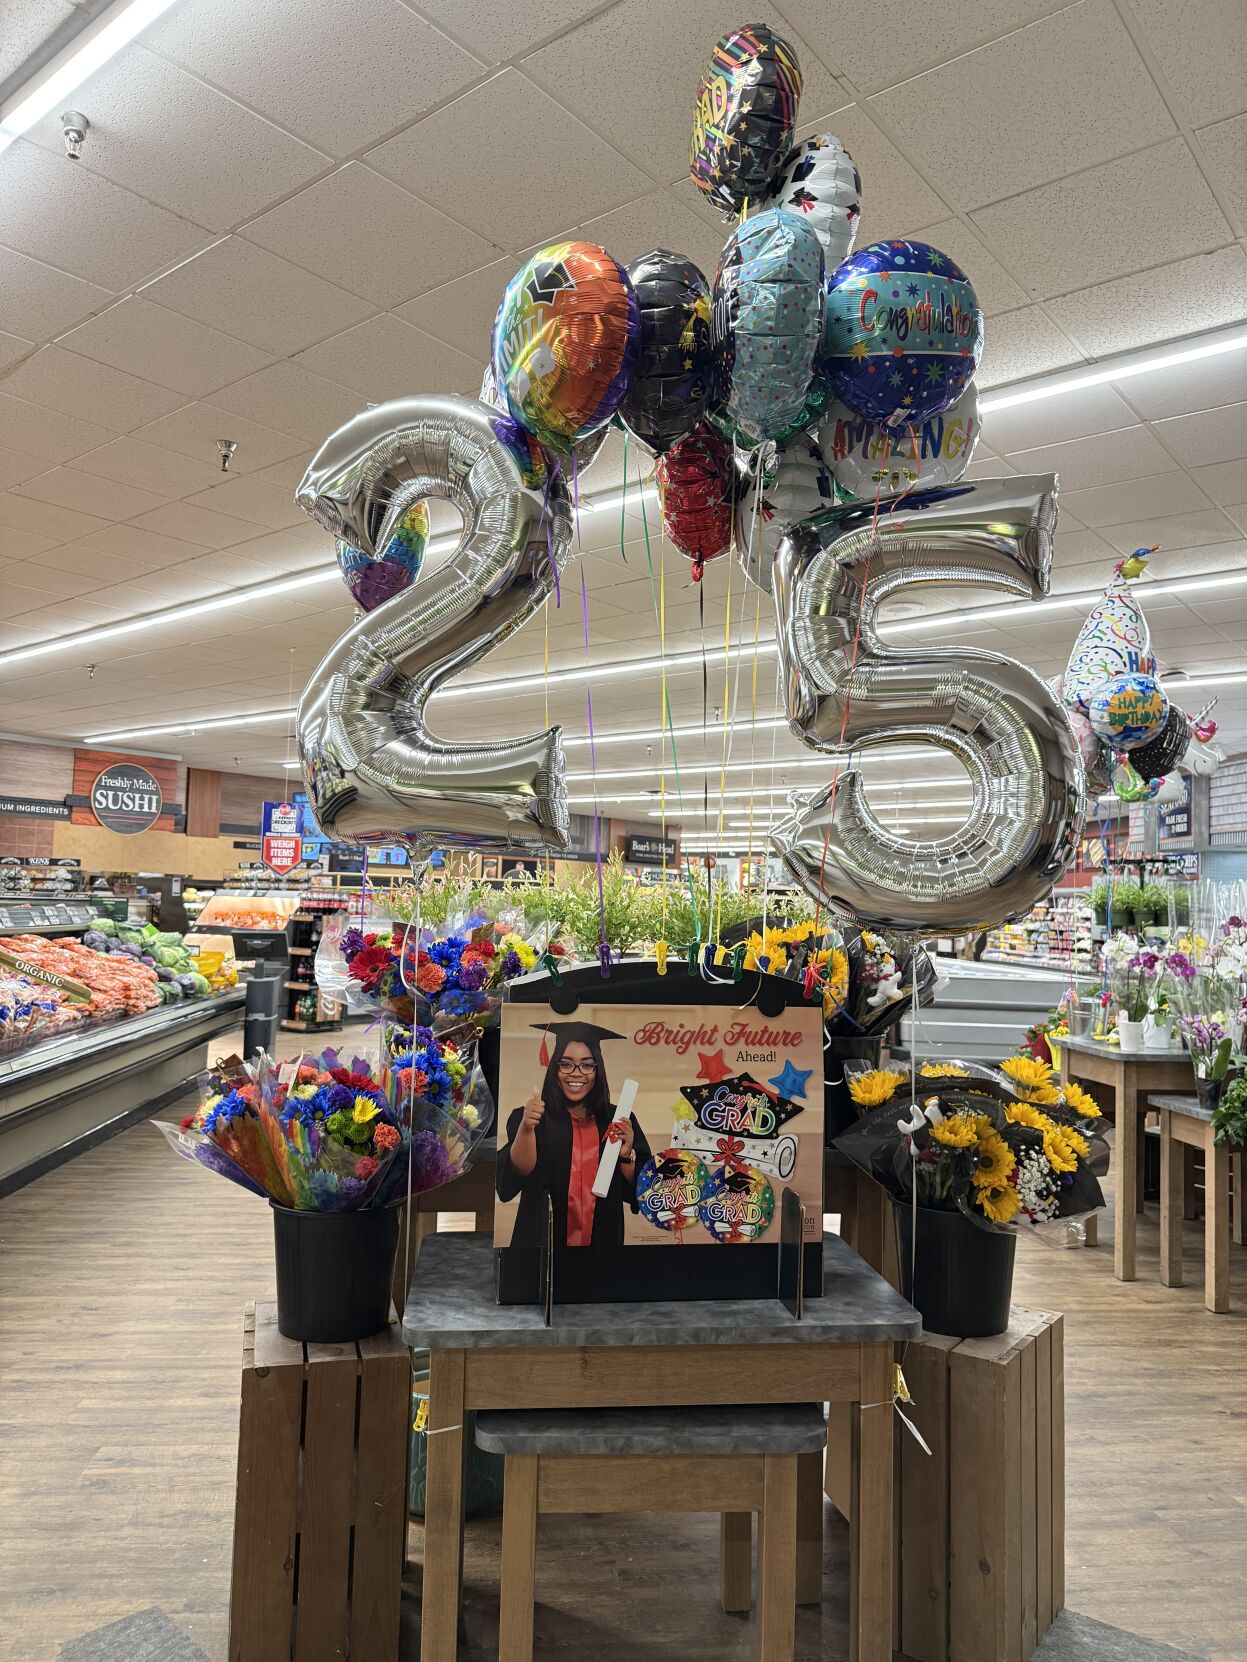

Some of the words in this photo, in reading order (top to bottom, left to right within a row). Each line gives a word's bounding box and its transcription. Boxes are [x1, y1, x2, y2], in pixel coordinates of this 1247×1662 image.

[1117, 694, 1155, 710] HAPPY
[1108, 708, 1165, 727] BIRTHDAY
[101, 775, 132, 790] Freshly
[133, 779, 157, 791] Made
[16, 804, 69, 815] INGREDIENTS
[94, 790, 159, 813] SUSHI
[270, 839, 296, 849] WEIGH
[270, 848, 295, 858] ITEMS
[632, 840, 650, 852] Boar's
[272, 857, 293, 866] HERE
[15, 960, 65, 987] ORGANIC
[633, 1022, 719, 1055] Bright
[723, 1022, 803, 1047] Future
[736, 1051, 777, 1062] Ahead!
[714, 1085, 770, 1110] Congrats
[701, 1100, 776, 1135] GRAD
[652, 1171, 696, 1191] Congrats
[646, 1185, 701, 1211] GRAD
[715, 1187, 760, 1204] Congrats
[707, 1201, 762, 1223] GRAD
